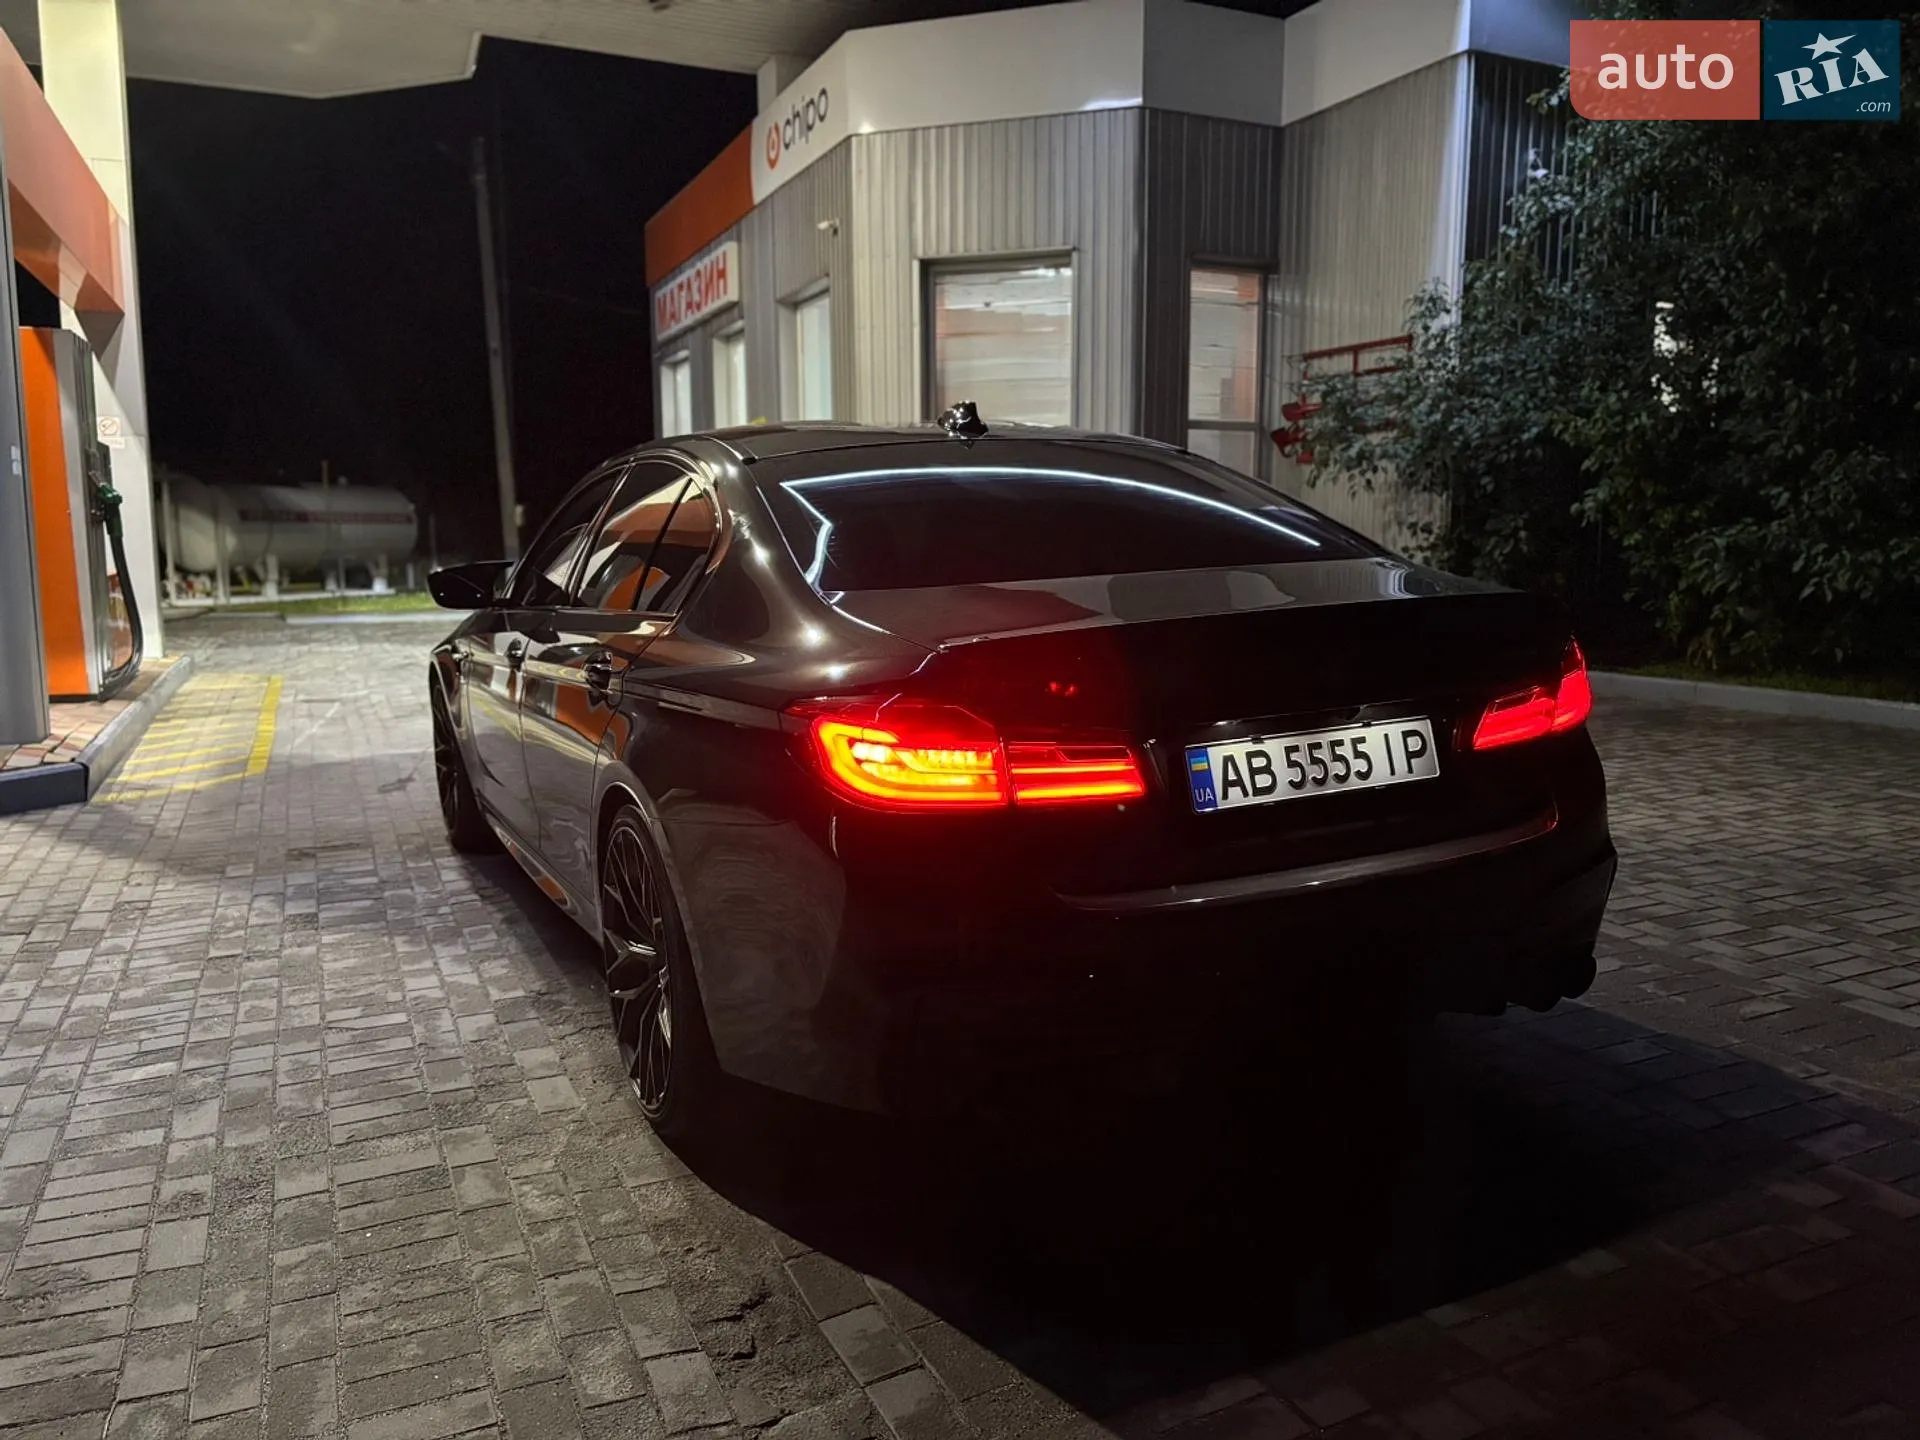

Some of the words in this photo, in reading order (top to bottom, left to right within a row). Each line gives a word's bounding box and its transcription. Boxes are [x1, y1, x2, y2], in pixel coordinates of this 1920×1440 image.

[783, 88, 829, 150] chipo
[657, 250, 728, 334] МАГАЗИН
[1194, 787, 1215, 803] UA
[1221, 749, 1278, 801] AB
[1283, 736, 1373, 790] 5555
[1383, 729, 1428, 777] IP
